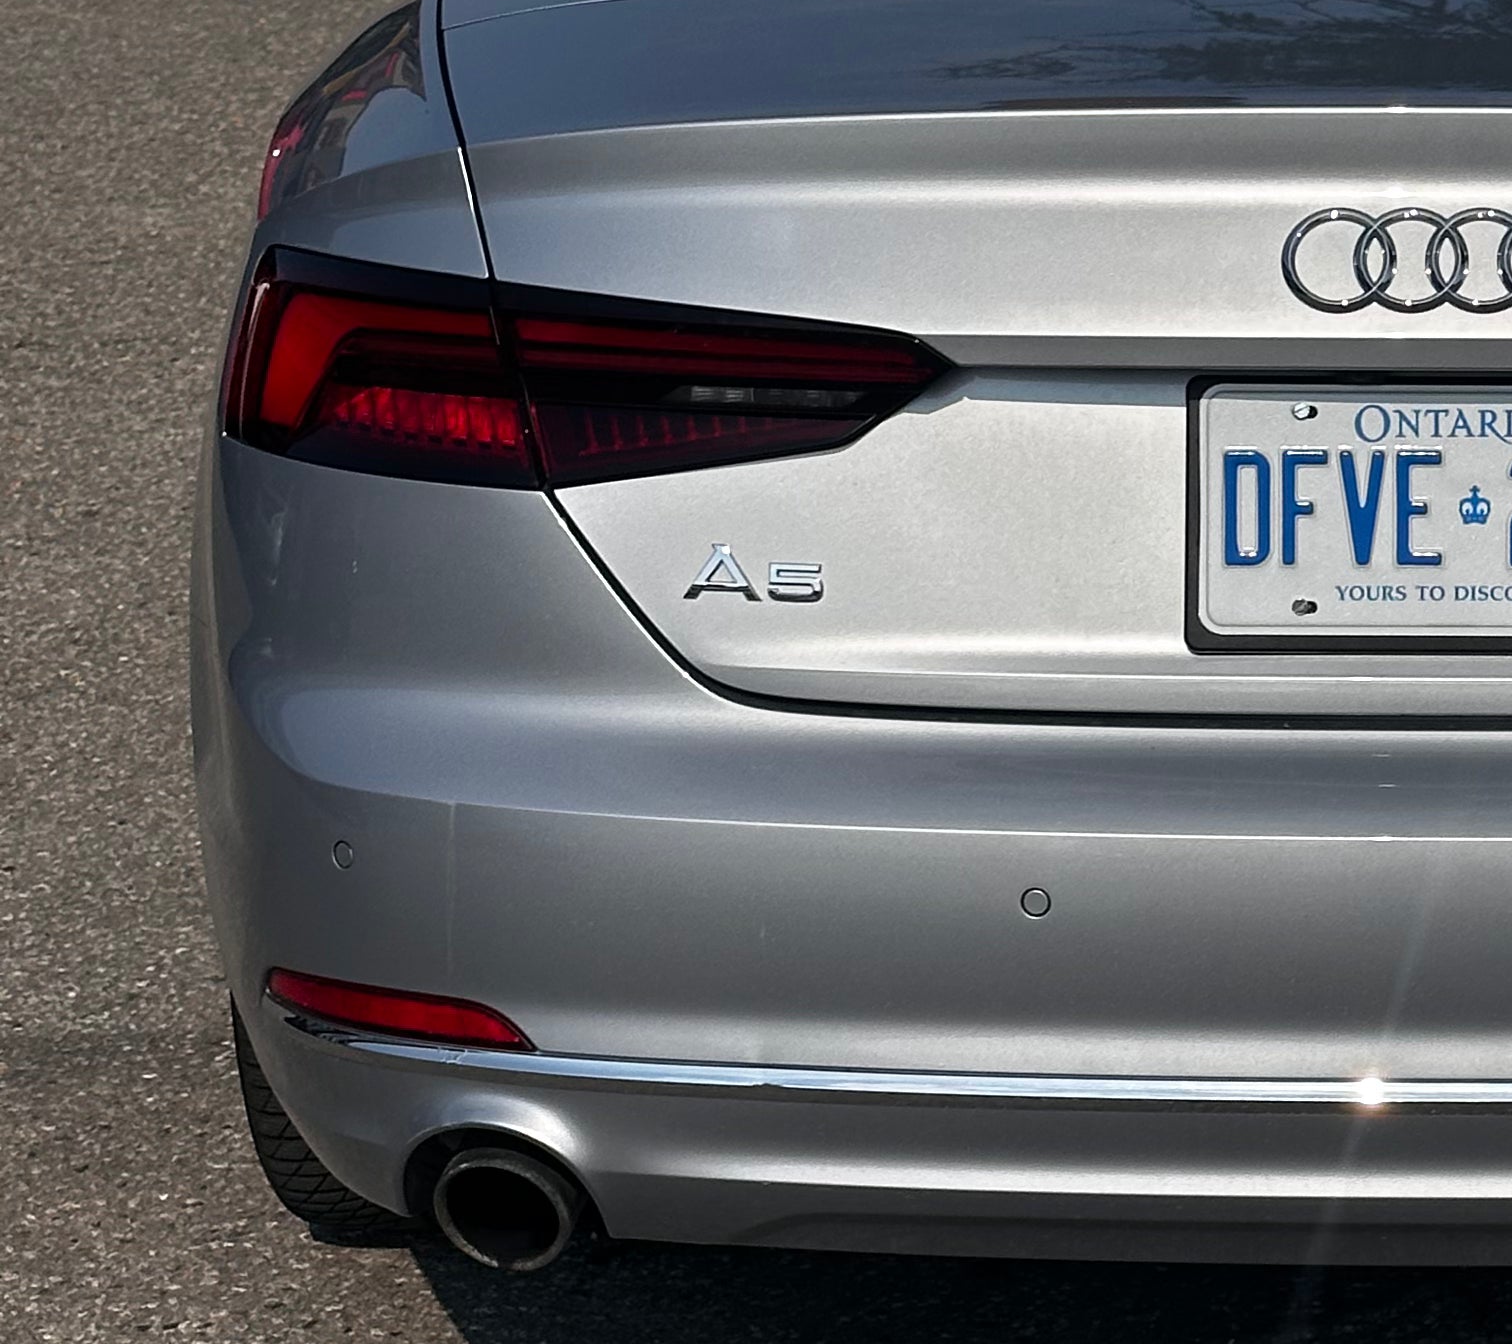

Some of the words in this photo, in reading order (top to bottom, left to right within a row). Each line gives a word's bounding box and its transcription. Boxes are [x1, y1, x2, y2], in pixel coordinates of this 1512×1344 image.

[1222, 446, 1444, 567] DFVE
[682, 542, 825, 604] A5
[1336, 584, 1406, 602] YOURS
[1417, 584, 1445, 602] TO
